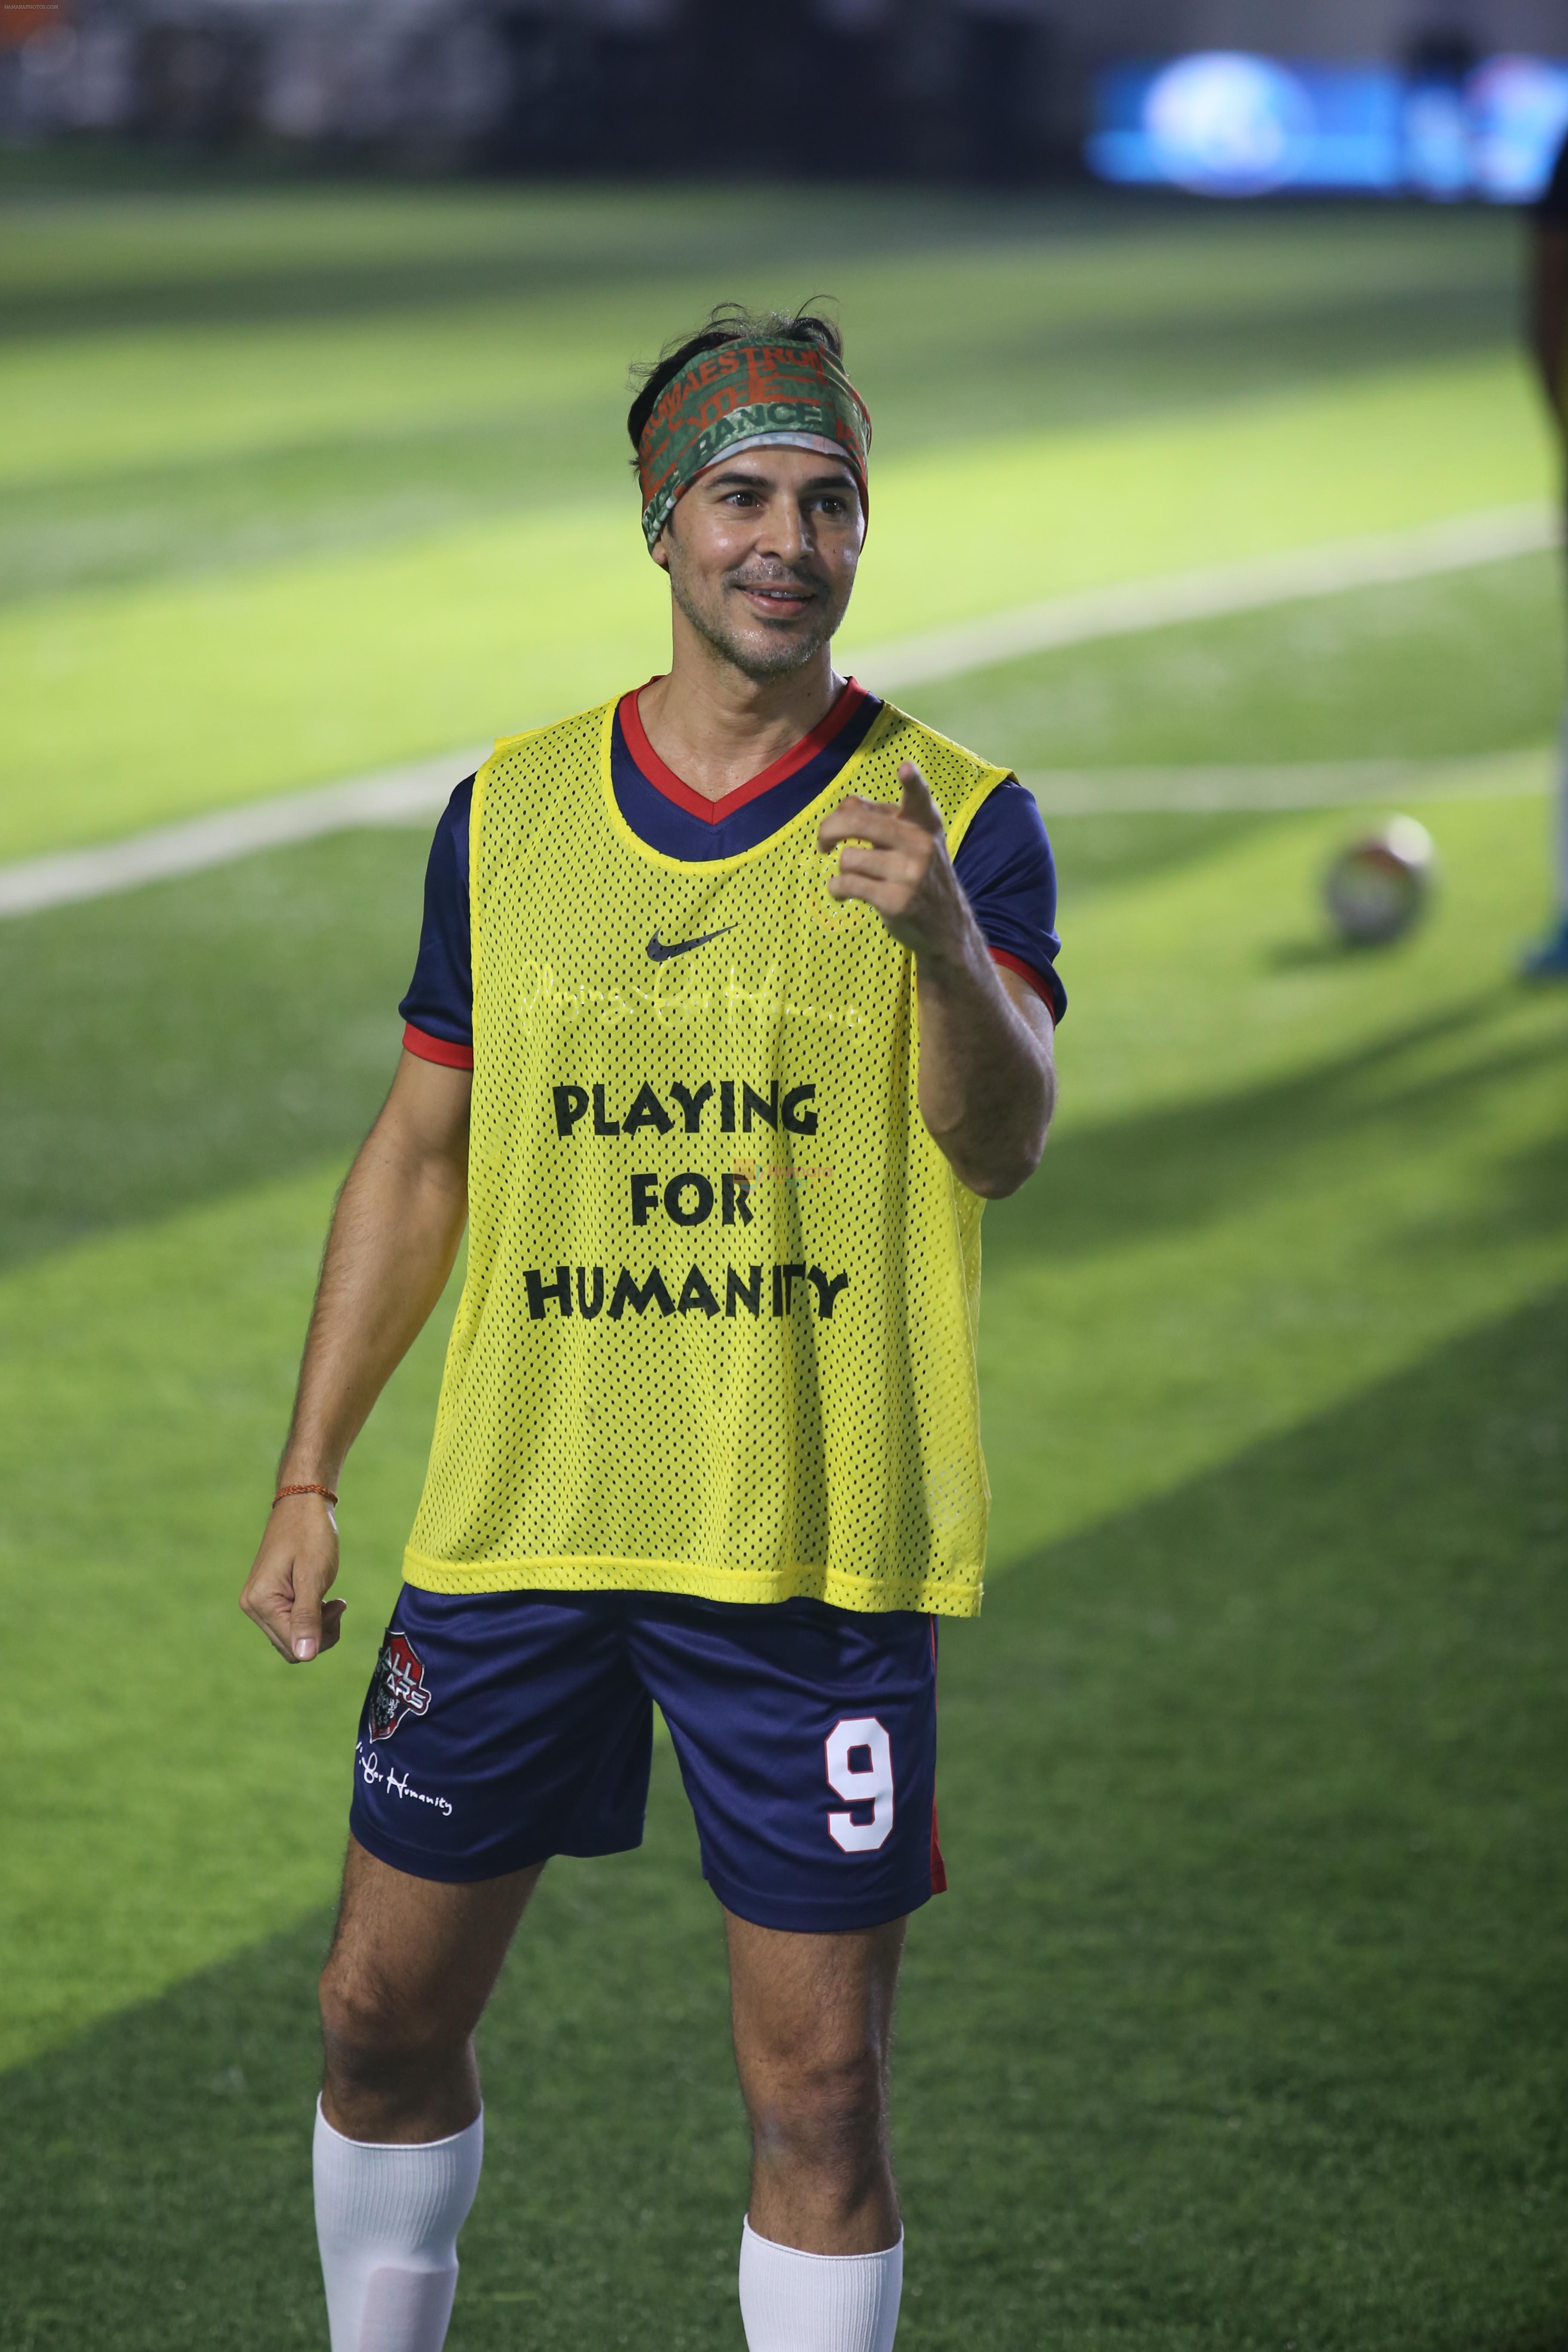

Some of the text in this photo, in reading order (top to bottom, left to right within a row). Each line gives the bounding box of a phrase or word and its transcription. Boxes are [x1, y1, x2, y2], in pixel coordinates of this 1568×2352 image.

[553, 1080, 818, 1137] PLAYING
[630, 1173, 753, 1226] FOR
[525, 1263, 848, 1321] HUMANITY
[382, 1646, 416, 1686] ALL
[387, 1767, 452, 1816] Humanity
[824, 1716, 894, 1853] 9
